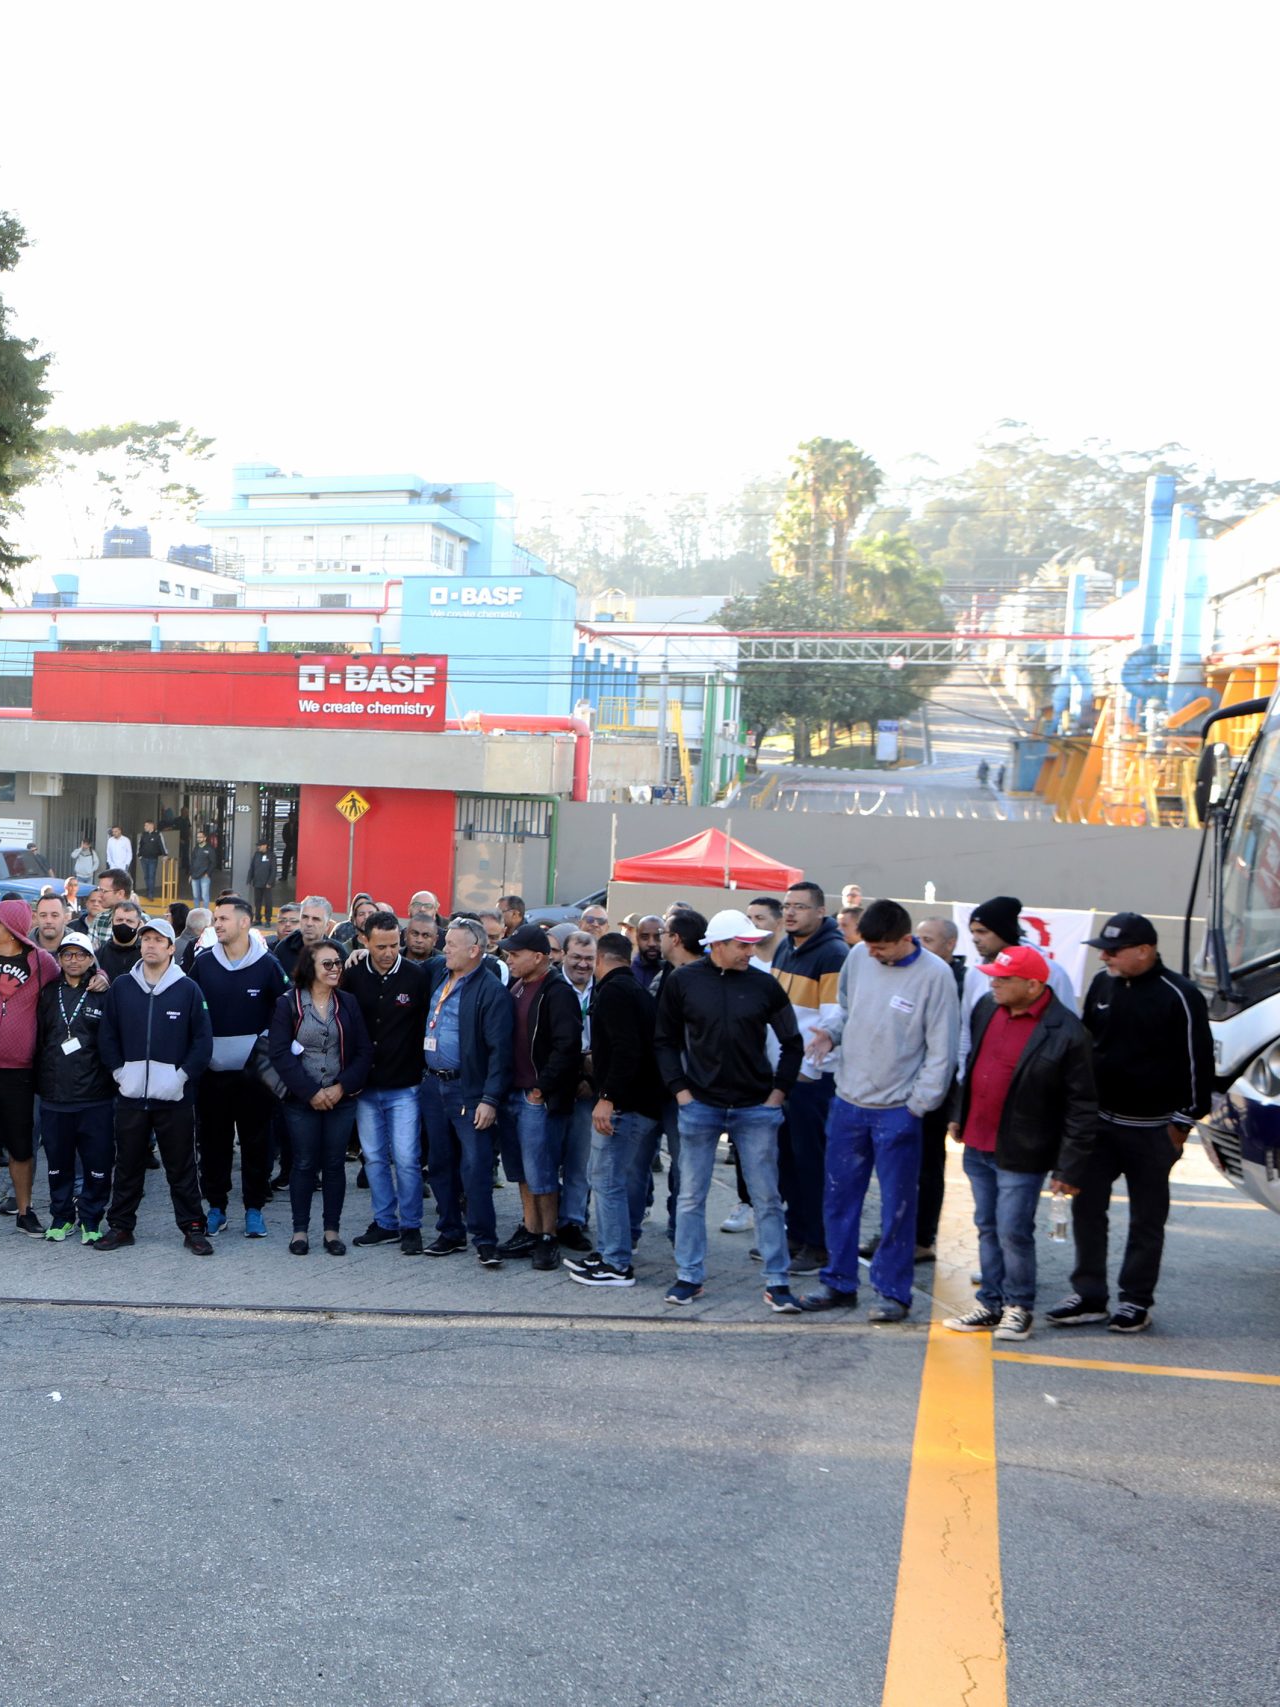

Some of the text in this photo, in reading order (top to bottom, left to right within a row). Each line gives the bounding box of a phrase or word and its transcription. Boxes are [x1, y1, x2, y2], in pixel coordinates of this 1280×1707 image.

[461, 586, 523, 606] BASF
[345, 665, 436, 693] BASF
[299, 700, 435, 718] We create chemistry
